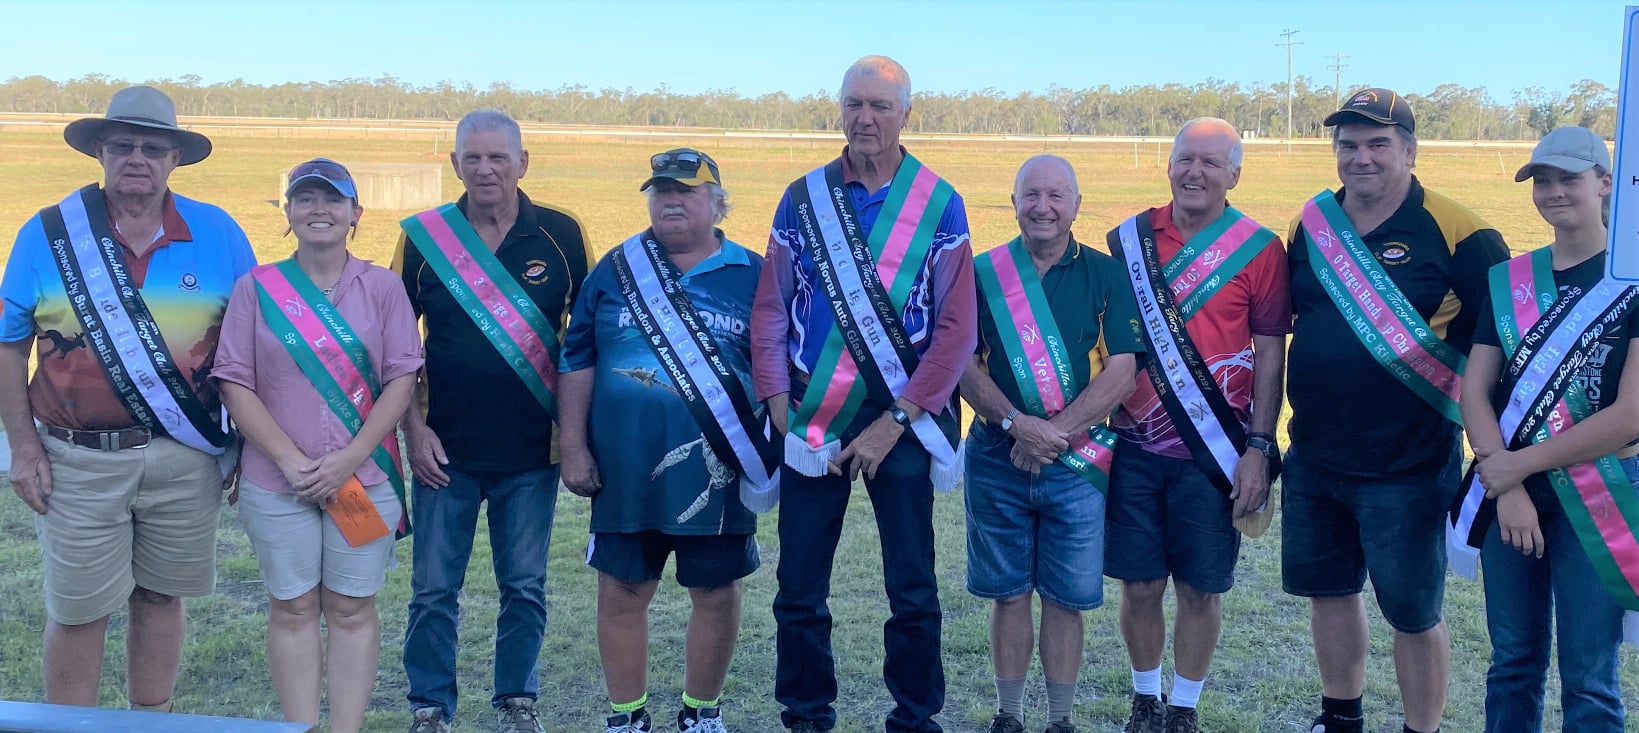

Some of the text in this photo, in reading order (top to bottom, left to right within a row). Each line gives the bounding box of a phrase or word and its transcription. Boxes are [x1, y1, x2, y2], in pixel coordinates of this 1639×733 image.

[798, 202, 820, 248] Sponsored
[812, 247, 822, 262] by
[818, 260, 837, 298] Novus
[832, 300, 849, 328] Auto
[846, 329, 866, 363] Glass
[833, 186, 856, 237] Chinchilla
[851, 237, 865, 261] Clay
[861, 263, 881, 300] Target
[877, 301, 895, 324] Club
[890, 326, 907, 349] 2021
[1173, 278, 1191, 296] Tar
[1341, 230, 1371, 271] Chinchilla
[1369, 270, 1387, 292] Clay
[1386, 292, 1416, 327] Target
[101, 237, 127, 286] Chinchilla
[134, 313, 158, 351] Target
[153, 351, 172, 375] Club
[316, 303, 354, 346] Chinchill
[448, 277, 483, 319] Sponed
[480, 318, 491, 331] by
[646, 239, 670, 279] Chinchilla
[675, 297, 699, 331] Target
[696, 331, 715, 352] Club
[709, 355, 730, 376] 2021
[1319, 267, 1411, 380] Sponsored by MPC Kinetic
[1339, 261, 1362, 293] Target
[1358, 289, 1395, 336] Handip
[1538, 286, 1582, 335] Sponsored
[53, 239, 154, 428] Sponsored by Surat Basin Real Estate
[622, 282, 631, 295] by
[627, 291, 653, 334] Brandon
[651, 334, 662, 346] &
[658, 346, 696, 402] Associates
[861, 315, 881, 347] Gun
[1148, 316, 1170, 355] High
[1166, 357, 1186, 390] Gun
[1525, 332, 1541, 346] by
[1581, 323, 1604, 348] Clay
[1047, 335, 1070, 386] Chinchilla
[1147, 357, 1167, 396] Toyota
[1553, 350, 1583, 390] Target
[1581, 367, 1602, 377] STONE
[1535, 390, 1555, 417] Club
